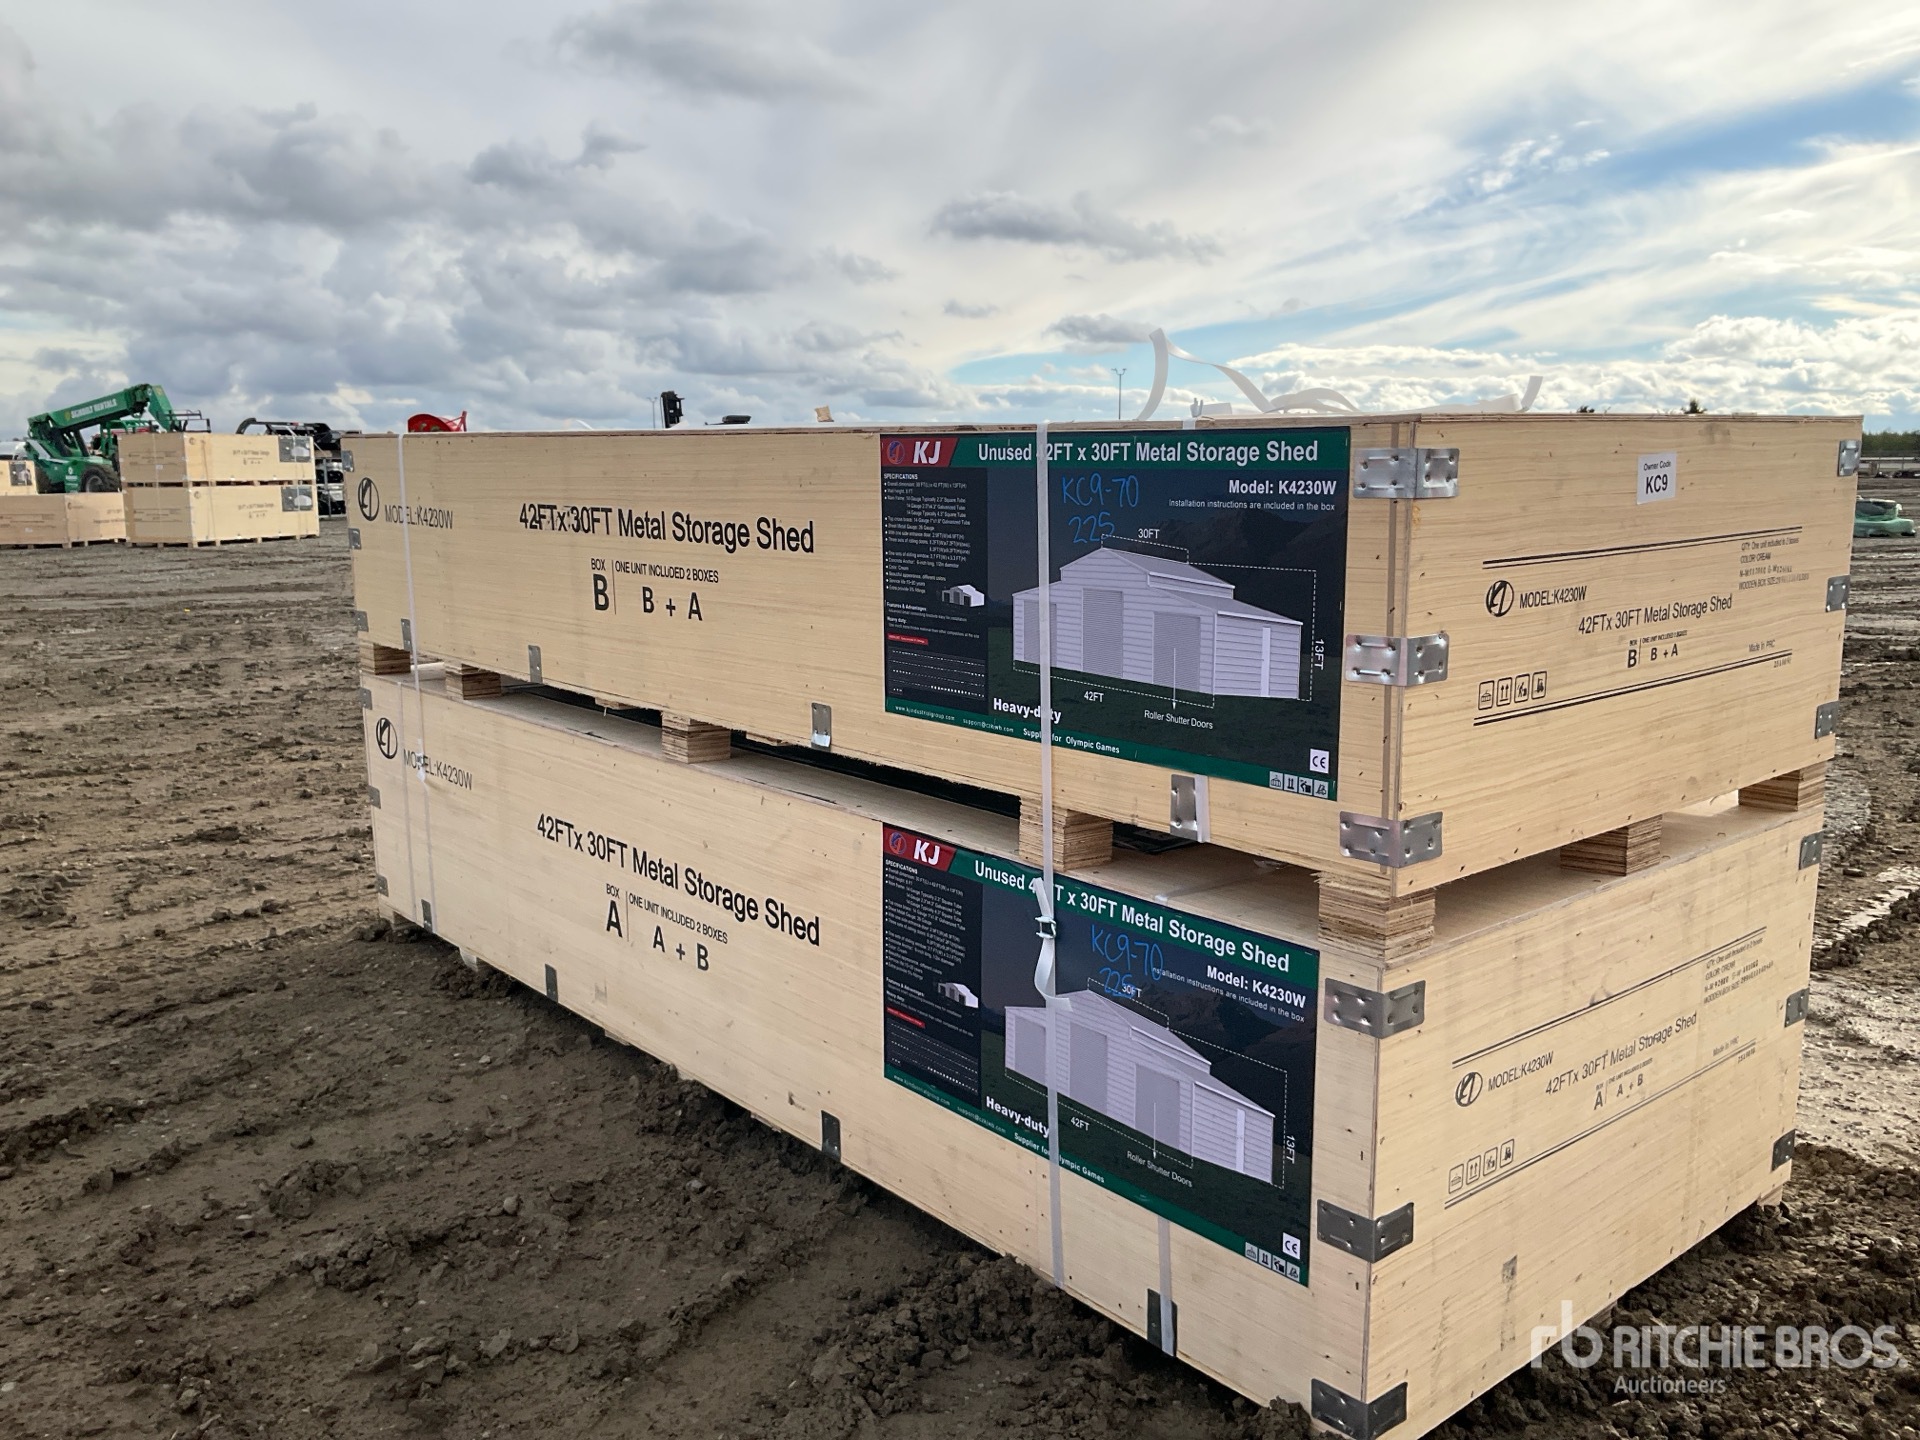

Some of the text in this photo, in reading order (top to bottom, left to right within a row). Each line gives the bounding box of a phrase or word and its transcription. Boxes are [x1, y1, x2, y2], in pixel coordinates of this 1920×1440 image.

[912, 441, 942, 465] KJ
[978, 440, 1318, 466] Unused 2FT x 30FT Metal Storage Shed
[1643, 460, 1672, 471] Owner Code
[1062, 473, 1139, 508] KC9-70
[1229, 480, 1336, 495] Model: K4230W
[1645, 473, 1669, 495] KC9
[1169, 498, 1206, 508] Installation
[1207, 500, 1248, 509] instructions
[1263, 501, 1295, 510] included
[1296, 502, 1304, 510] in
[1306, 502, 1318, 510] the
[1320, 502, 1335, 510] box
[618, 512, 666, 541] Metal
[672, 516, 750, 554] Storage
[757, 517, 814, 553] Shed
[1068, 511, 1115, 543] 225
[1138, 528, 1160, 538] 30FT
[591, 558, 606, 571] BOX
[615, 561, 719, 583] ONE UNIT INCLUDED 2 BOXES
[593, 574, 609, 611] B
[642, 587, 654, 613] B
[688, 592, 703, 621] A
[1519, 585, 1587, 610] MODEL:K4230W
[1615, 608, 1642, 629] 30FT
[1644, 604, 1670, 624] Metal
[1672, 599, 1707, 621] Storage
[1710, 593, 1733, 612] Shed
[1314, 638, 1324, 670] 13FT
[1627, 649, 1637, 668] B
[1650, 647, 1657, 661] B
[1671, 643, 1678, 656] A
[994, 698, 1061, 724] Heavy-dty
[1084, 691, 1104, 702] 42FT
[1144, 710, 1213, 729] Roller Shutter Doors
[1052, 733, 1061, 742] for
[1065, 736, 1094, 750] Olympic
[1095, 742, 1120, 754] Games
[404, 748, 472, 790] MOEL:K4230W
[914, 840, 940, 865] KJ
[587, 831, 627, 869] 30FT
[633, 846, 678, 890] Metal
[684, 867, 758, 921] Storage
[765, 898, 820, 947] Shed
[606, 883, 620, 899] BOX
[606, 900, 622, 938] A
[628, 893, 728, 944] ONE UNIT INCLUDED 2 BOXES
[975, 860, 1289, 972] Unused 4T x 30FT Metal Storage Shed
[653, 925, 665, 953] A
[697, 942, 709, 971] B
[1091, 924, 1163, 981] KC9-70
[1187, 978, 1223, 995] instructions
[1226, 989, 1236, 1000] are
[1239, 994, 1268, 1010] included
[1278, 1007, 1289, 1017] the
[1291, 1011, 1304, 1022] box
[1207, 965, 1306, 1008] Model: K4230W
[1582, 1051, 1608, 1082] 30FT
[1610, 1041, 1636, 1066] Metal
[1638, 1028, 1672, 1051] Storage
[1675, 1010, 1697, 1036] Shed
[1488, 1051, 1554, 1092] MODEL:K4230W
[1616, 1084, 1623, 1097] A
[1637, 1073, 1643, 1086] B
[1594, 1091, 1604, 1110] A
[986, 1096, 1049, 1138] Heavy-duty
[1071, 1116, 1090, 1131] 42FT
[1014, 1132, 1039, 1151] Supplier
[1060, 1155, 1081, 1171] lympic
[1082, 1166, 1105, 1183] Games
[1286, 1135, 1295, 1164] 13FT
[1126, 1151, 1192, 1188] Roller Shutter Doors
